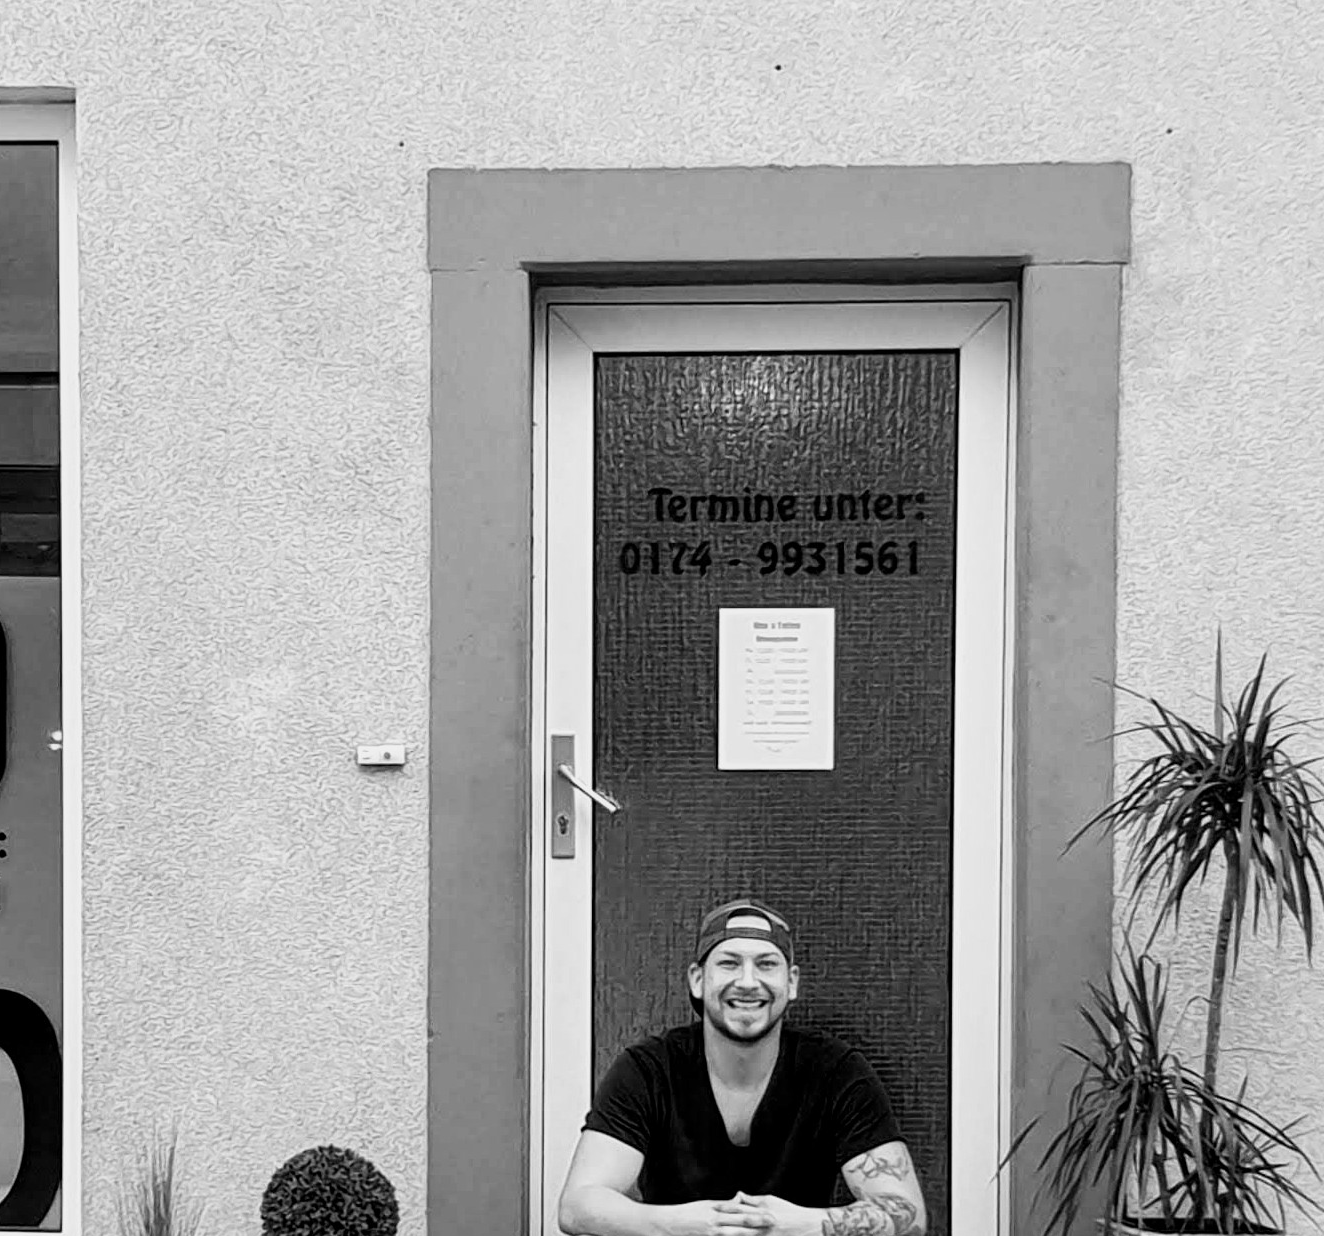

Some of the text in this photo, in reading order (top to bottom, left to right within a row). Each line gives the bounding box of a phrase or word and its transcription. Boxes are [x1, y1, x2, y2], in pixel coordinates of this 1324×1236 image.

[648, 488, 926, 522] Termine unter:
[621, 541, 712, 577] 0174
[757, 541, 919, 576] 9931561
